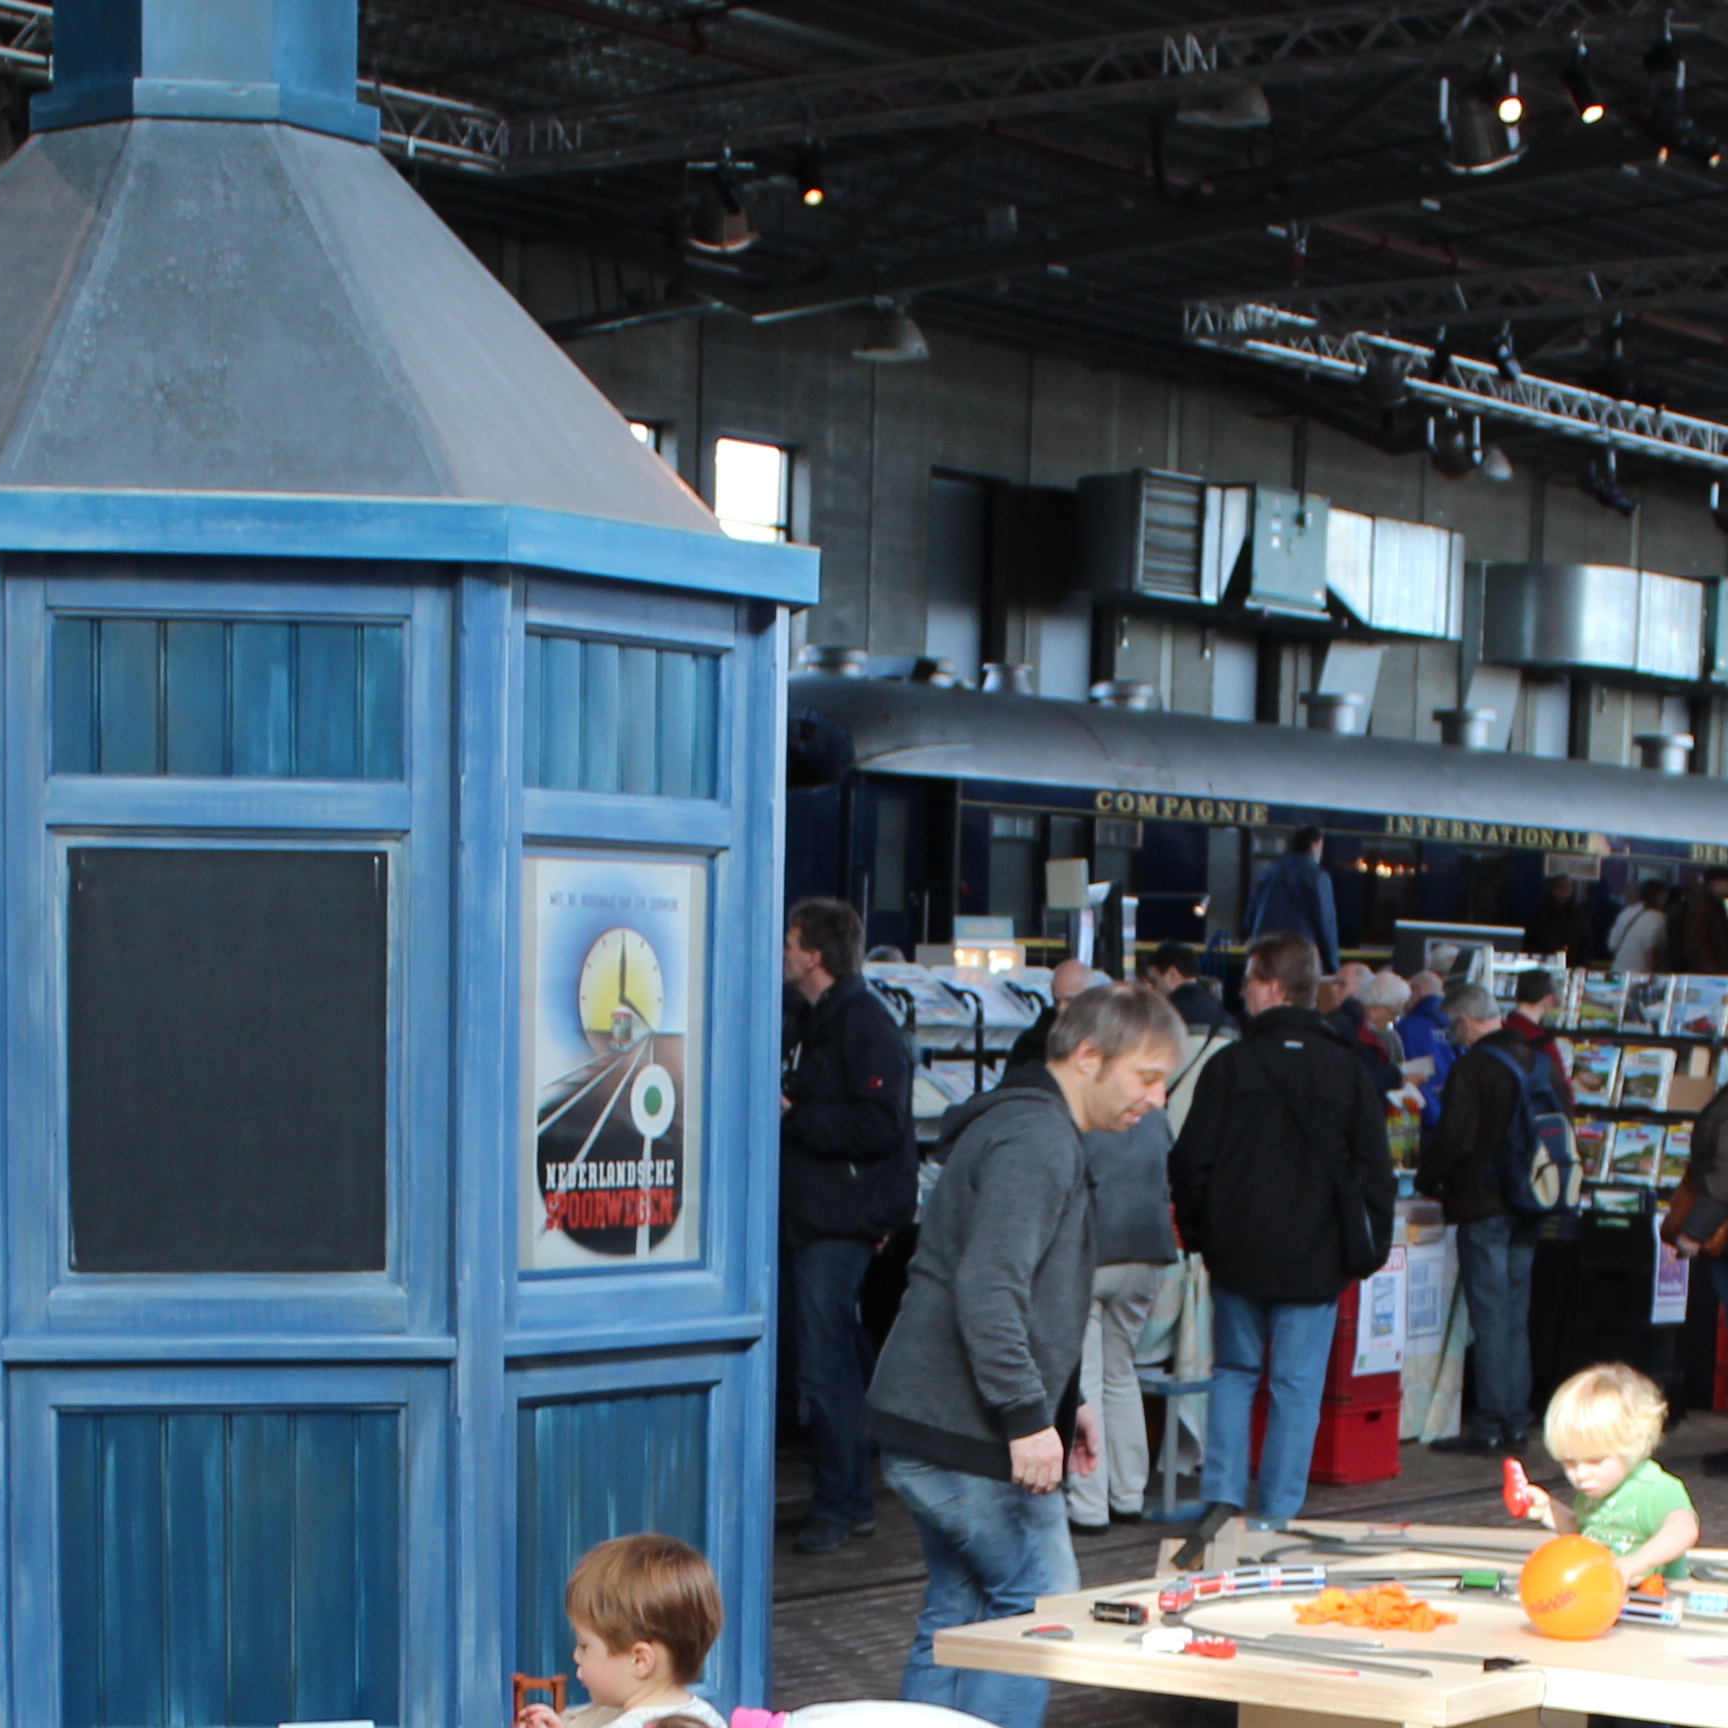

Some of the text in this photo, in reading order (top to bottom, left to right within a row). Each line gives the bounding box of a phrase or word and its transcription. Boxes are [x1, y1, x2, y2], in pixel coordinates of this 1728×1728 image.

[1096, 790, 1268, 826] COMPAGNIE
[1385, 815, 1590, 850] INTERNATIONAL
[545, 1159, 674, 1190] NEDERLANDSCHE
[545, 1188, 674, 1231] SPOORWEGEN
